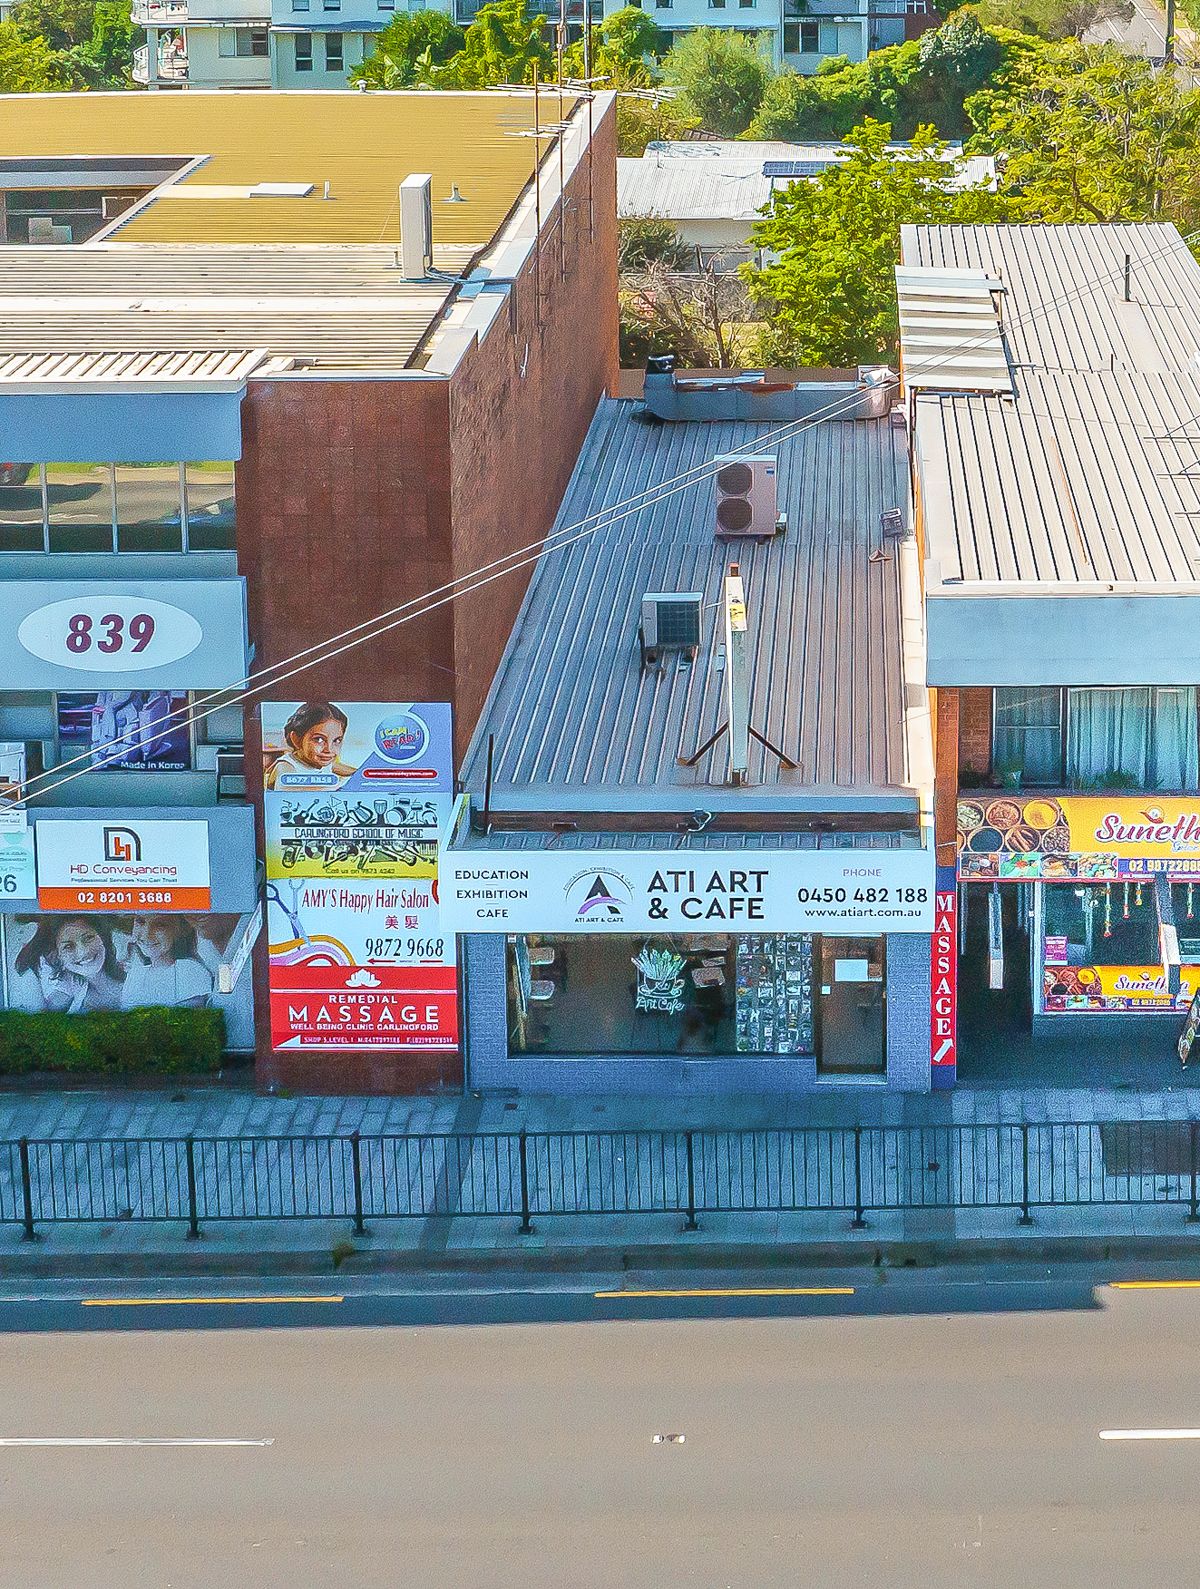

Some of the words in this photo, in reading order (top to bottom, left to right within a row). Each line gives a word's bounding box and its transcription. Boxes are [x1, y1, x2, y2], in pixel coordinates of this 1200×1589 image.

[66, 613, 155, 653] 839
[121, 761, 146, 769] Made
[147, 761, 157, 769] in
[158, 761, 185, 769] Korea
[294, 828, 350, 839] CARLINGFORD
[352, 828, 383, 839] SCHOOL
[385, 828, 396, 839] OF
[398, 828, 424, 839] MUSIC
[71, 864, 88, 874] HD
[93, 864, 177, 876] Conveyancing
[1128, 859, 1144, 872] 02
[455, 870, 529, 880] EDUCATION
[842, 868, 882, 877] PHONE
[0, 873, 17, 892] 6
[647, 870, 695, 893] ATI
[705, 870, 769, 893] ART
[77, 893, 94, 903] 02
[99, 893, 132, 903] 8201
[139, 893, 172, 903] 3688
[456, 889, 528, 899] EXHIBITION
[798, 888, 847, 903] 0450
[853, 888, 889, 903] 482
[896, 888, 928, 903] 188
[302, 889, 337, 908] AMY'S
[340, 888, 370, 913] Happy
[376, 888, 399, 908] Hair
[401, 888, 429, 908] Salon
[476, 909, 508, 918] CAFE
[648, 897, 669, 919] &
[680, 897, 765, 919] CAFE
[804, 907, 922, 917] www.atiart.com.au
[365, 938, 401, 956] 9872
[406, 938, 444, 956] 9668
[935, 894, 954, 1036] MASSAGE
[329, 995, 398, 1004] REMEDIAL
[288, 1005, 439, 1022] MASSAGE
[290, 1023, 314, 1031] WELL
[316, 1023, 343, 1031] BEING
[346, 1023, 374, 1031] CLINIC
[377, 1023, 439, 1031] CARLINGFORD
